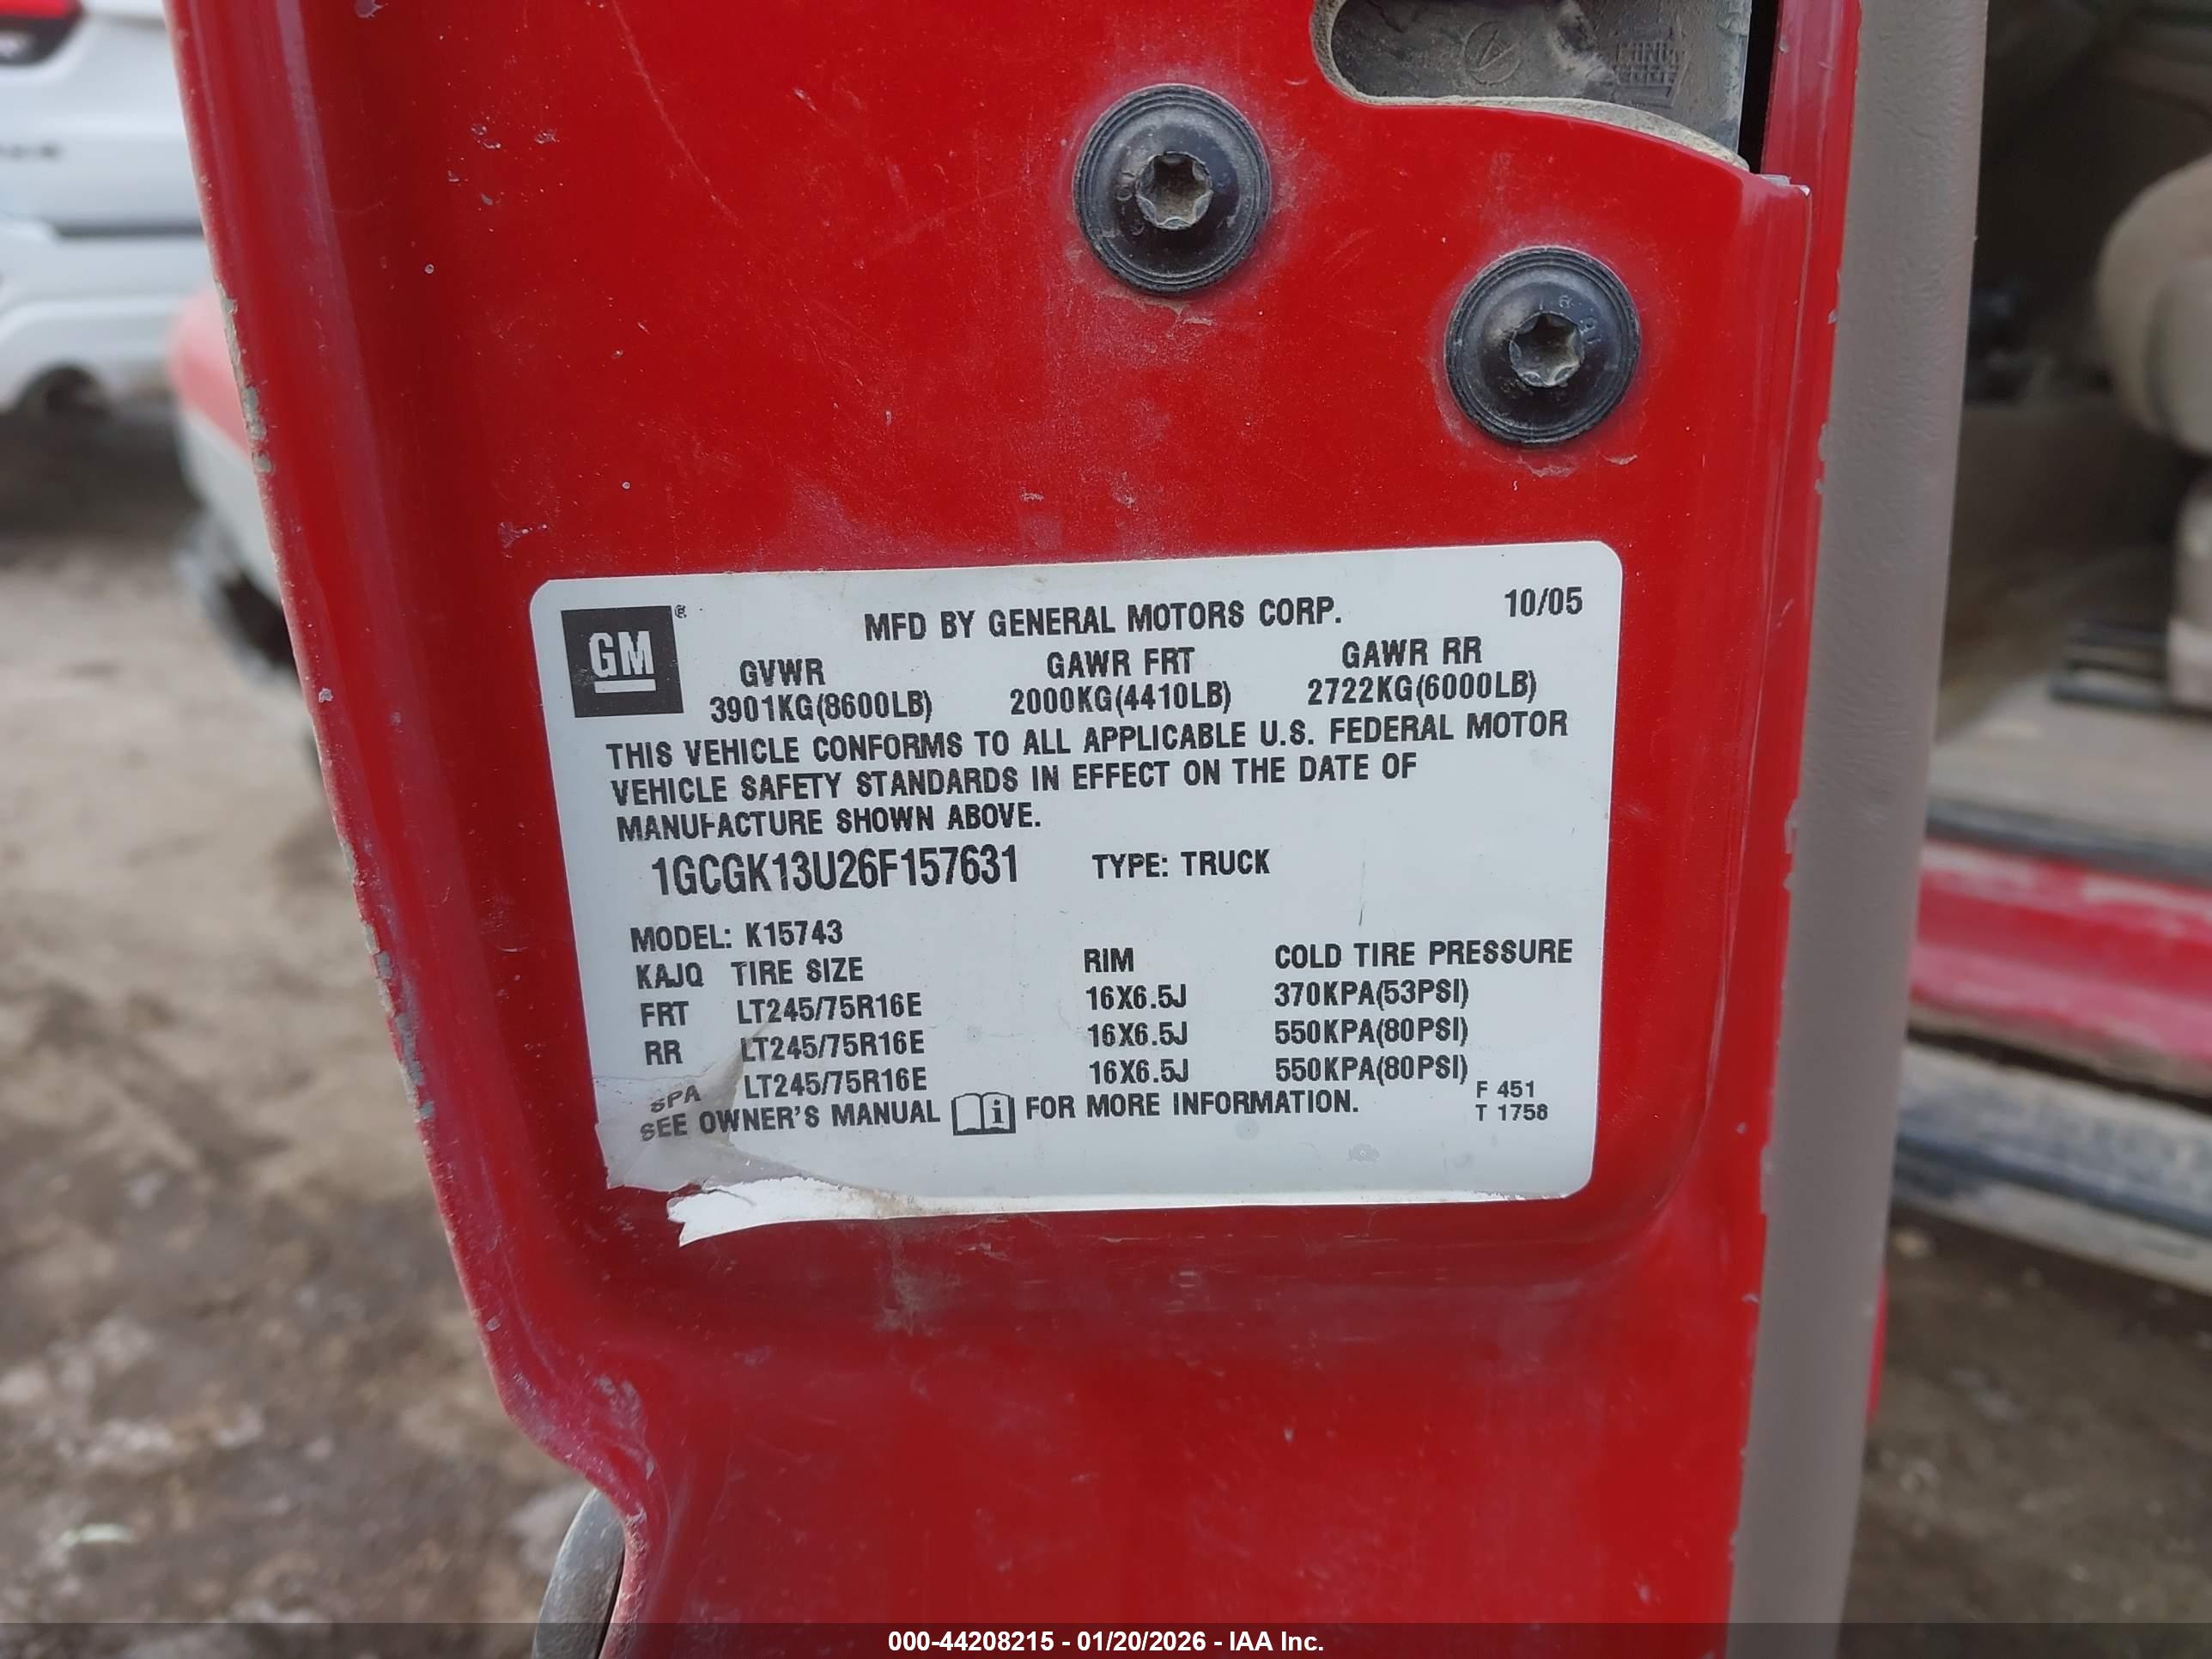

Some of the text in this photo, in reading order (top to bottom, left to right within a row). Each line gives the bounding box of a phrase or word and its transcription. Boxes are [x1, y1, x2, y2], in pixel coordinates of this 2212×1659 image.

[1504, 586, 1583, 617] 10/05
[865, 597, 1340, 641] MFD BY GENERAL MOTORS CORP.
[589, 631, 653, 678] GM
[1048, 647, 1194, 678] GAWR FRT
[1342, 636, 1482, 668] GAWR RR
[740, 659, 825, 687] GVWR
[1011, 681, 1231, 718] 2000KG(4410LB)
[1309, 671, 1536, 708] 2722KG(6000LB)
[710, 690, 932, 726] 3901KG(8600LB)
[606, 710, 1567, 769] THIS VEHICLE CONFORMS TO ALL APPLICABLE U.S. FEDERAL MOTOR
[611, 752, 1416, 806] VEHICLE SAFETY STANDARDS IN EFFECT ON THE DATE OF
[617, 802, 1040, 842] MANUFACTURE SHOWN ABOVE.
[652, 844, 1017, 896] 1GCGK13U26F157631
[1092, 849, 1270, 878] TYPE: TRUCK
[630, 920, 842, 952] MODEL: K15743
[1085, 948, 1133, 973] RIM
[1275, 939, 1572, 969] COLD TIRE PRESSURE
[636, 957, 863, 989] KAJQ TIRE SIZE
[641, 993, 921, 1027] FRT LT245/75R16E
[1086, 984, 1186, 1010] 16X6.5J
[1274, 979, 1468, 1011] 370KPA(53PSI)
[645, 1030, 924, 1065] RR LT245/75R16E
[1088, 1022, 1187, 1047] 16X6.5J
[1275, 1017, 1468, 1048] 550KPA(80PSI)
[1090, 1059, 1188, 1085] 16X6.5J
[1276, 1054, 1468, 1086] 550KPA(80PSI)
[651, 1066, 927, 1113] SPA LT245/75R16E
[1026, 1090, 1358, 1120] FOR MORE INFORMATION.
[1477, 1080, 1534, 1098] F 451
[641, 1113, 688, 1141] SEE
[831, 1100, 940, 1127] MANUAL
[1475, 1103, 1547, 1121] T 1758
